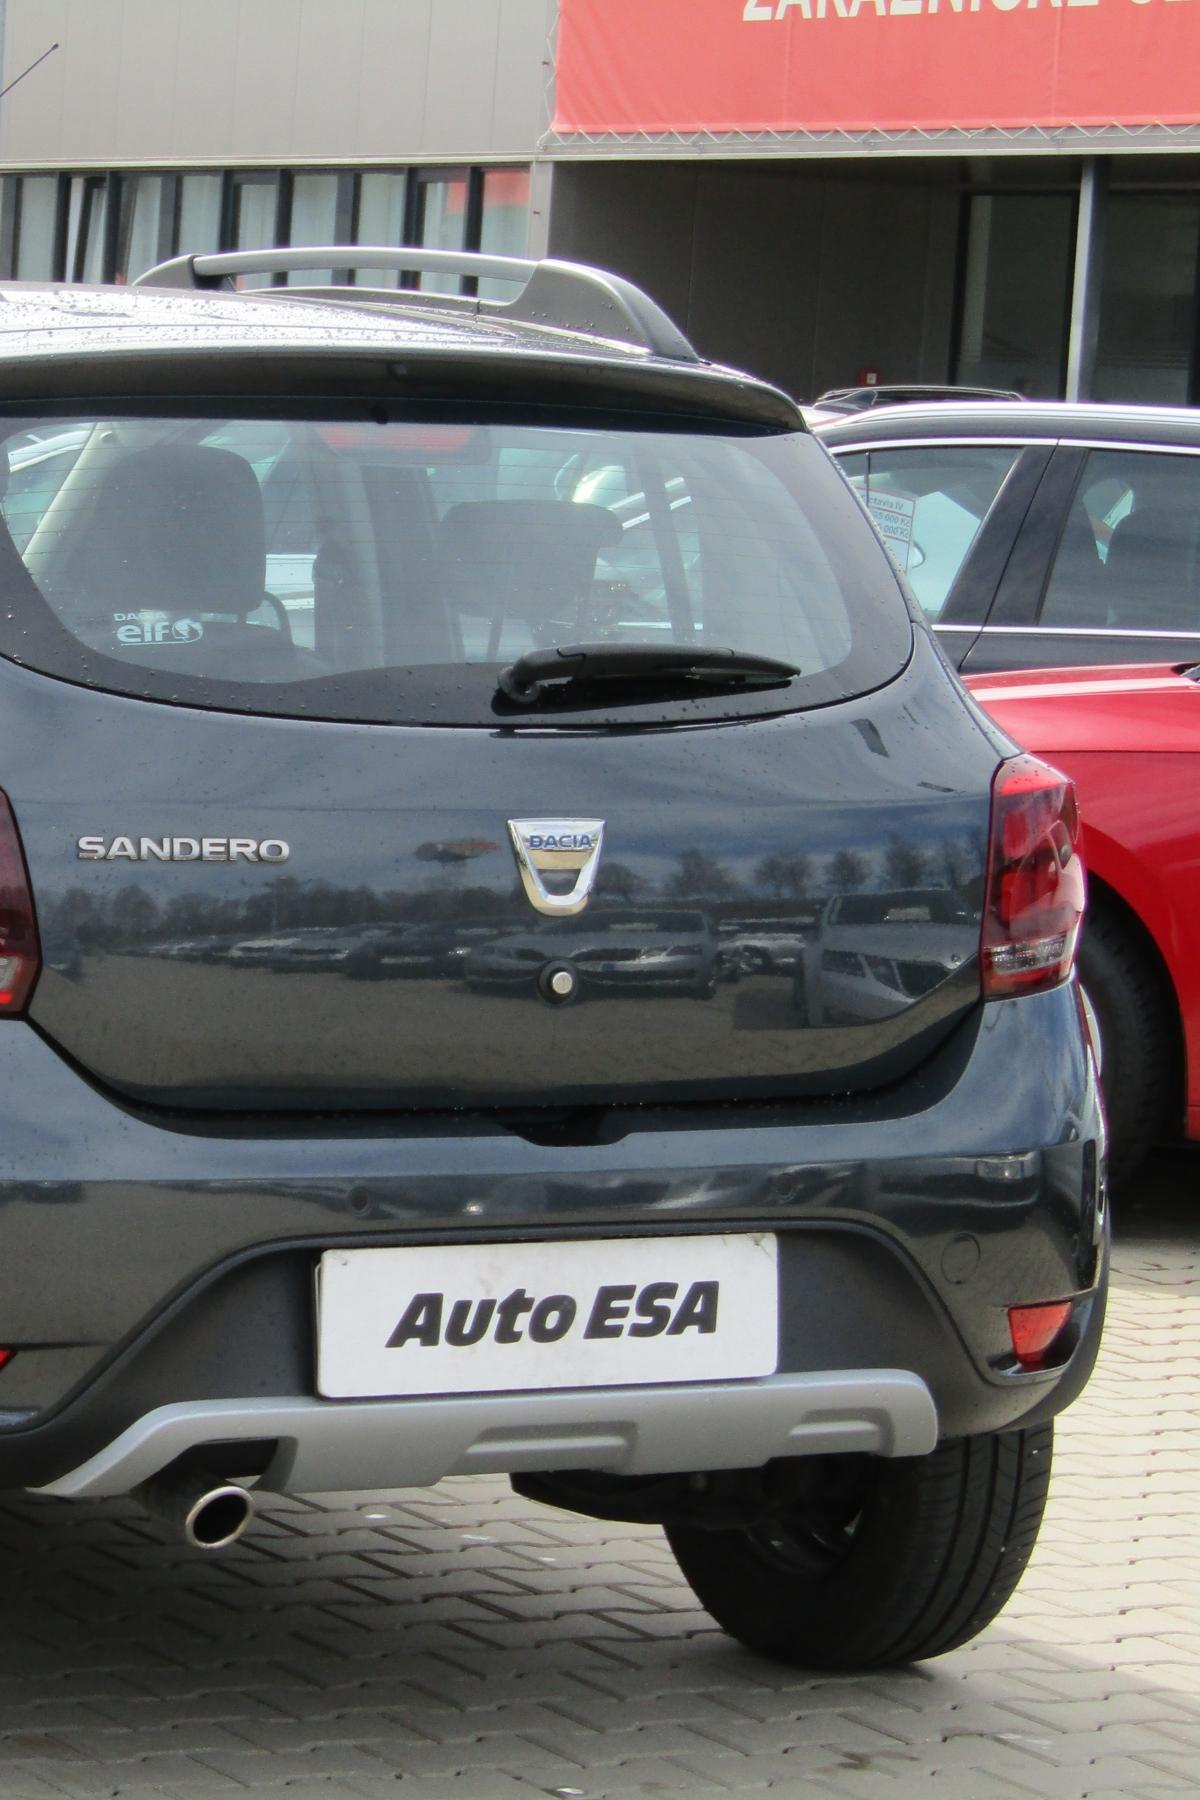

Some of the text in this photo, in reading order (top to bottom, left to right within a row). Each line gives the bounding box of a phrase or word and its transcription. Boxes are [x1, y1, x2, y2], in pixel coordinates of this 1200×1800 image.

[78, 836, 290, 862] SANDERO
[529, 835, 593, 848] DACIA
[384, 1280, 719, 1347] Auto ESA
